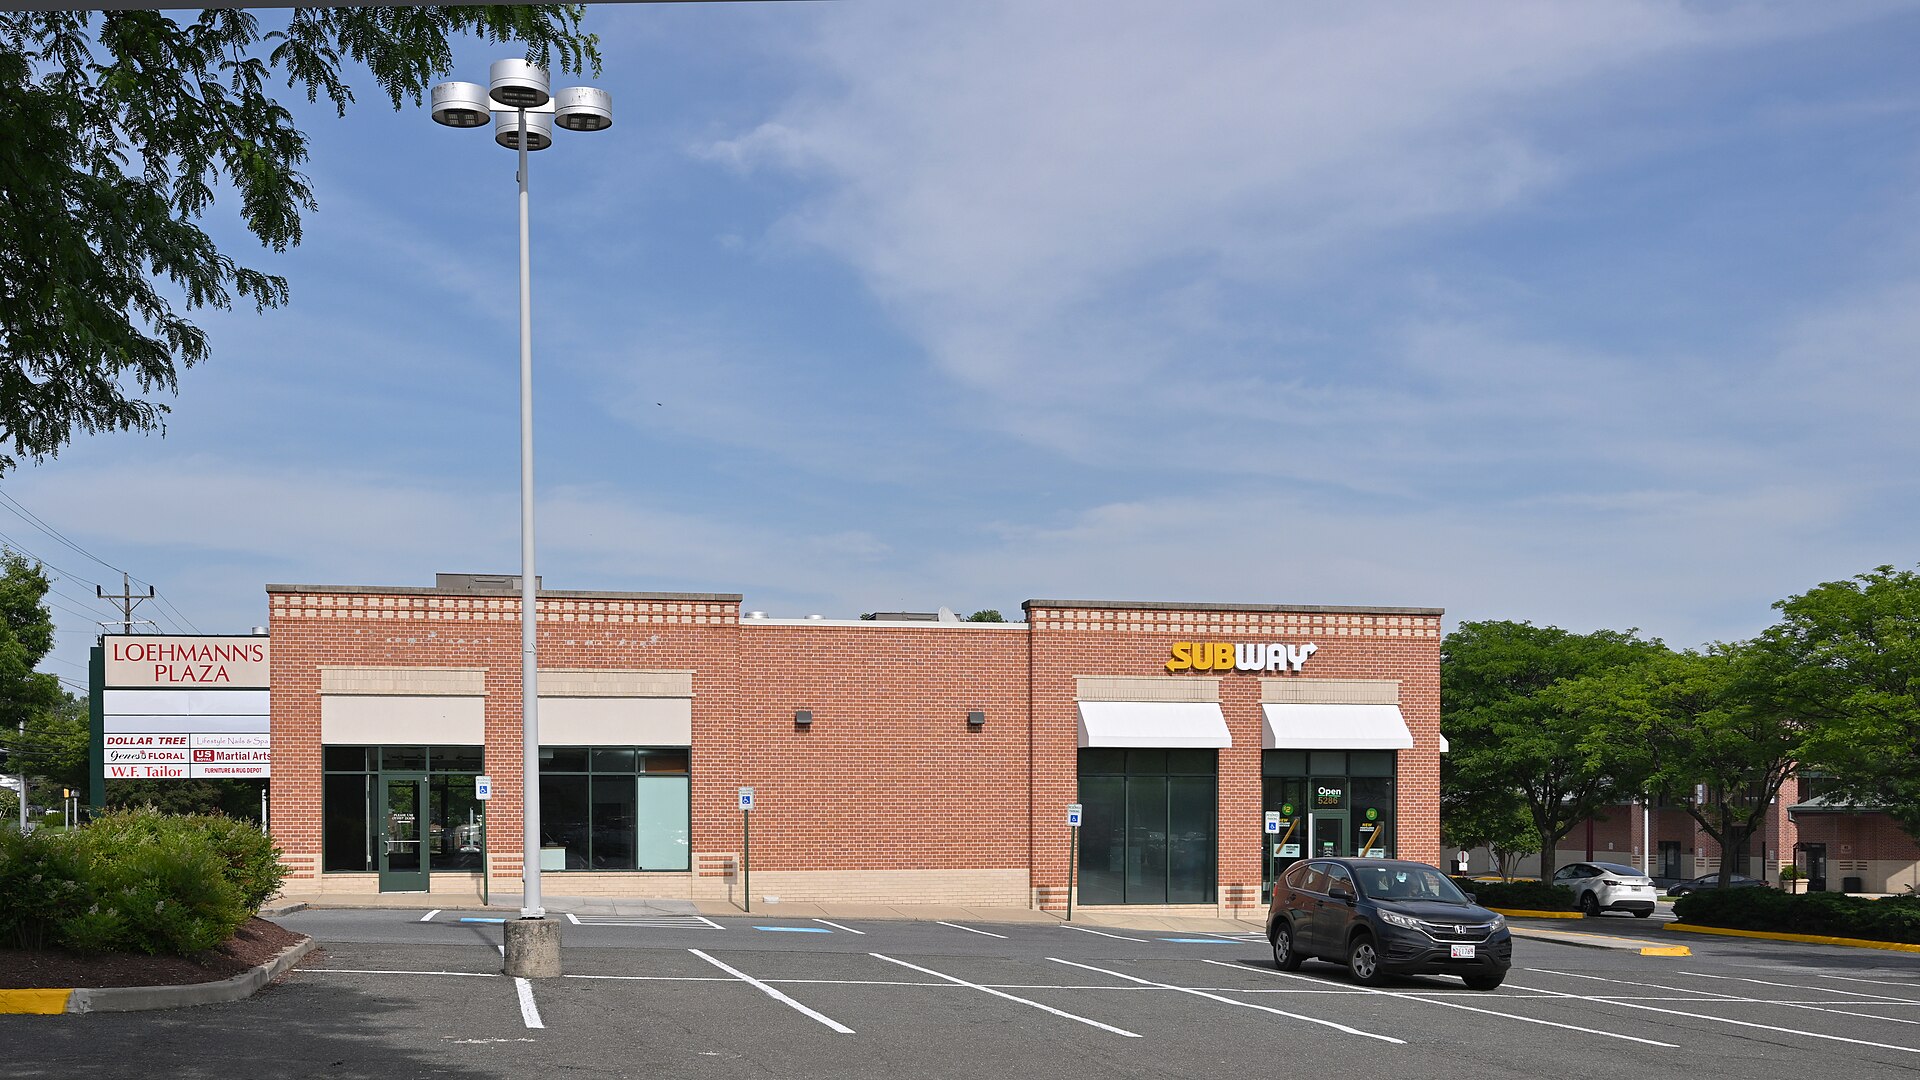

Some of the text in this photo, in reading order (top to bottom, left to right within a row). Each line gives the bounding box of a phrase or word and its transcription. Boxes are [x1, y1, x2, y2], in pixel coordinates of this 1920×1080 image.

[113, 643, 264, 662] LOEHMANN'S
[1165, 641, 1318, 672] SUBWAY
[155, 664, 230, 682] PLAZA
[106, 737, 187, 745] DOLLAR TREE
[196, 736, 226, 746] Lifestyle
[227, 737, 246, 745] Nails
[252, 736, 269, 746] Spa
[148, 752, 185, 760] FLORAL
[196, 750, 212, 758] US
[216, 751, 271, 761] Martial Arts
[111, 765, 183, 777] W.F. Tailor
[1317, 786, 1342, 797] Open
